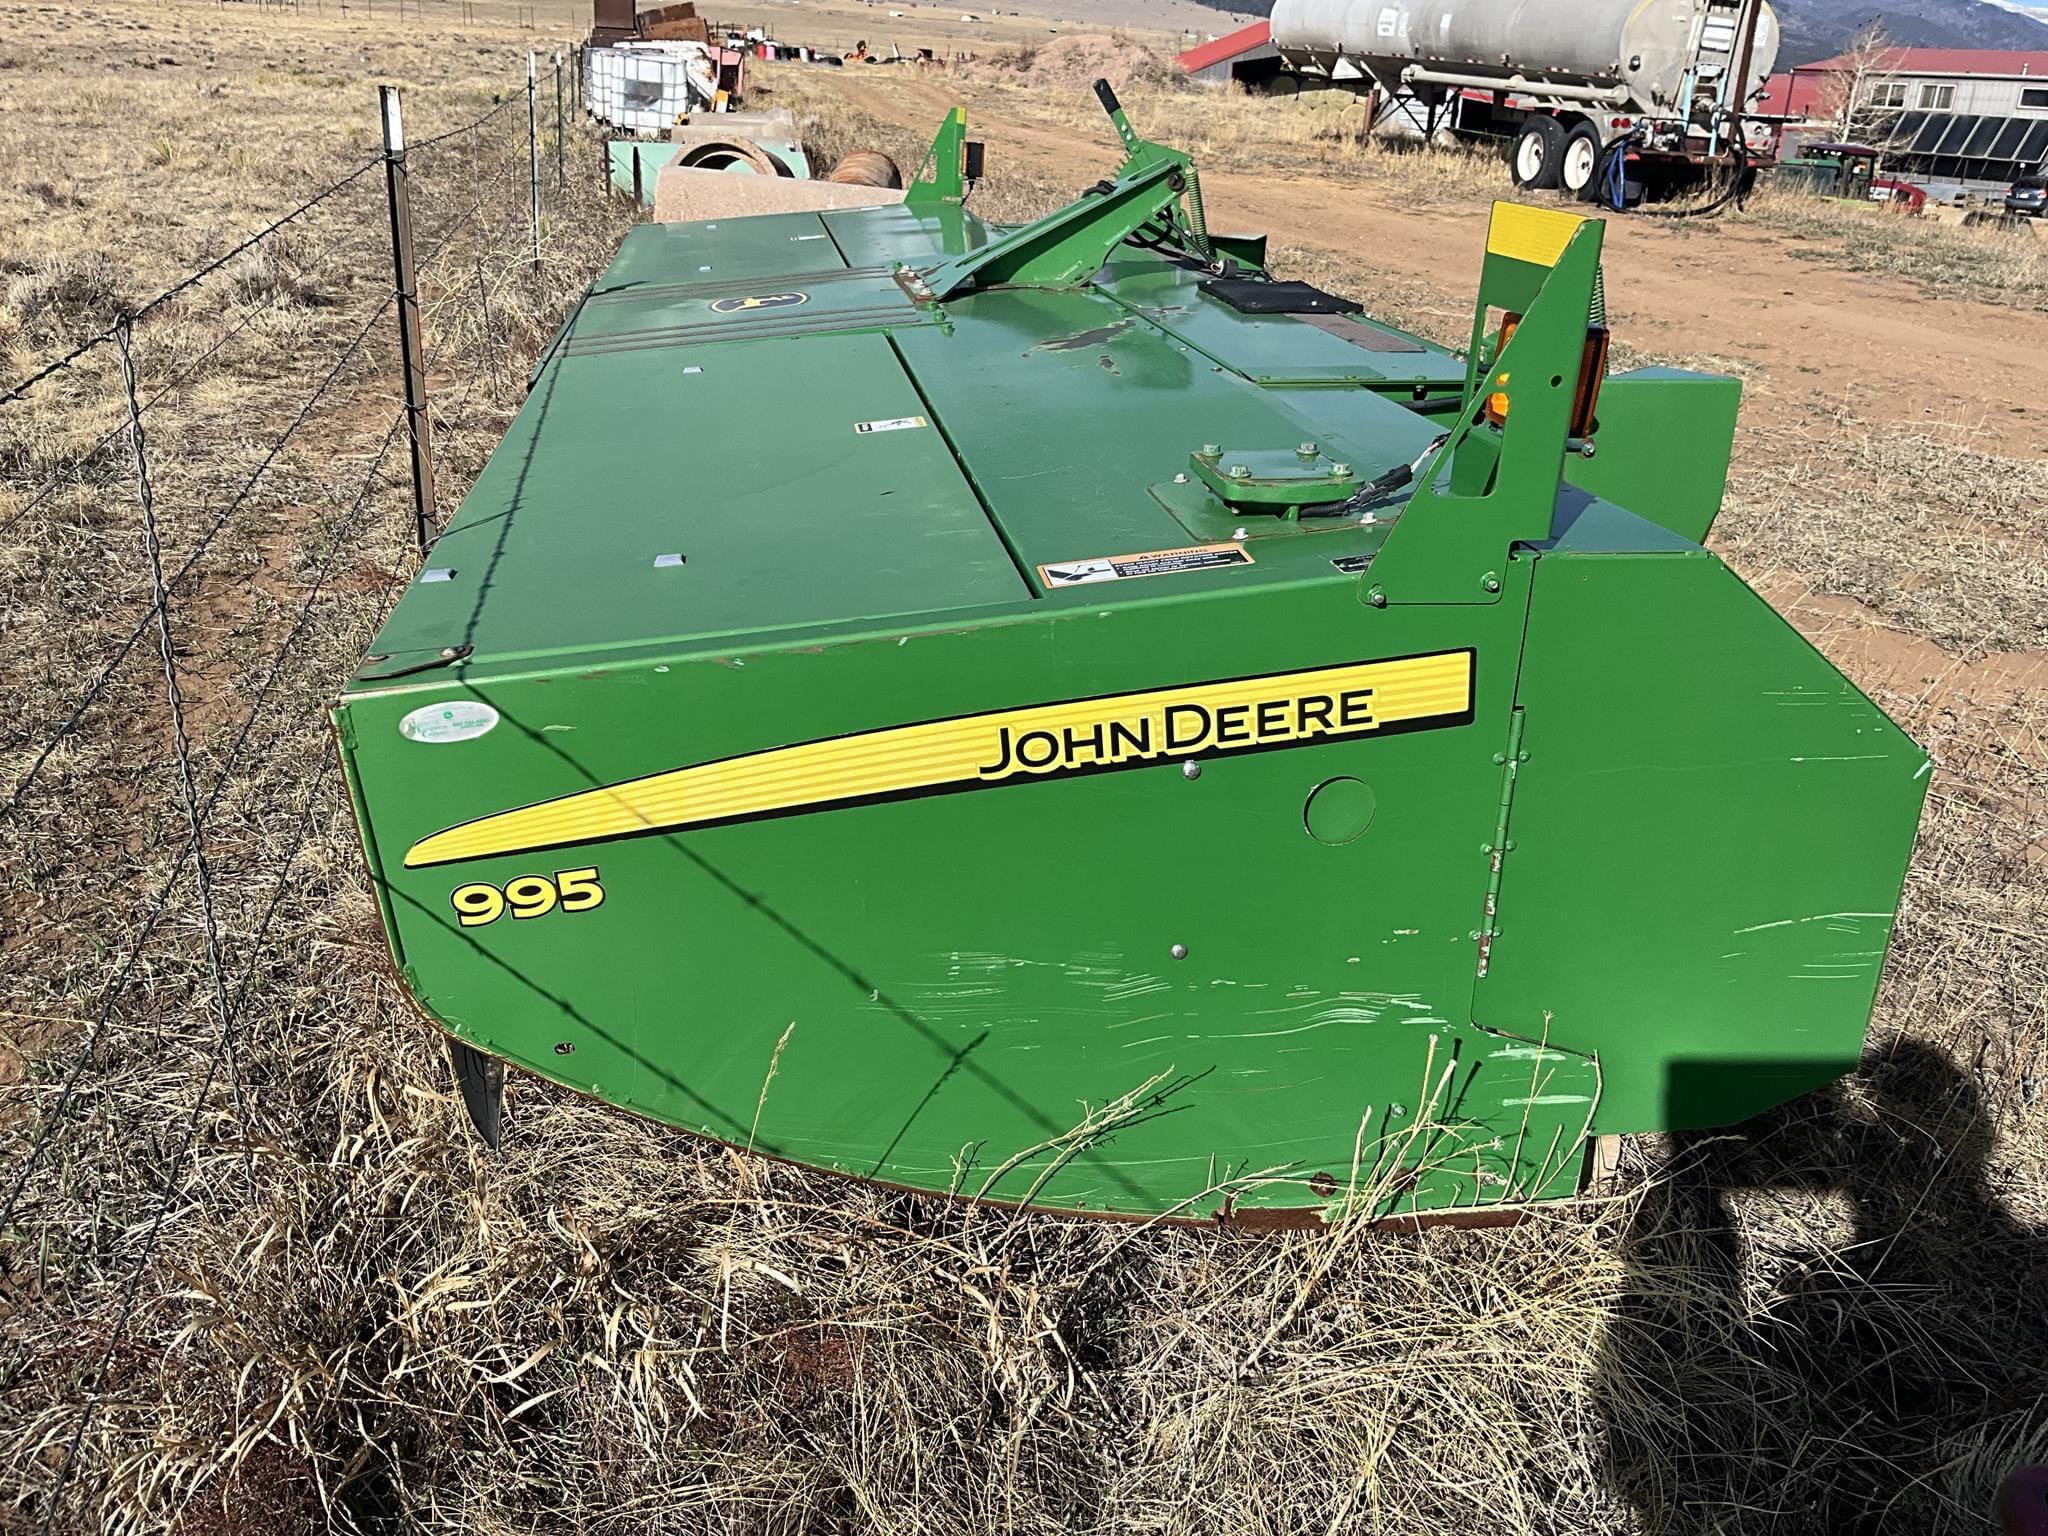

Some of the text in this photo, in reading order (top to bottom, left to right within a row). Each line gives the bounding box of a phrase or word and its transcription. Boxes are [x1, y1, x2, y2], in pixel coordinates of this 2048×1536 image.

[1152, 549, 1208, 558] WARNING
[979, 689, 1374, 774] JOHN DEERE
[451, 866, 606, 927] 995
